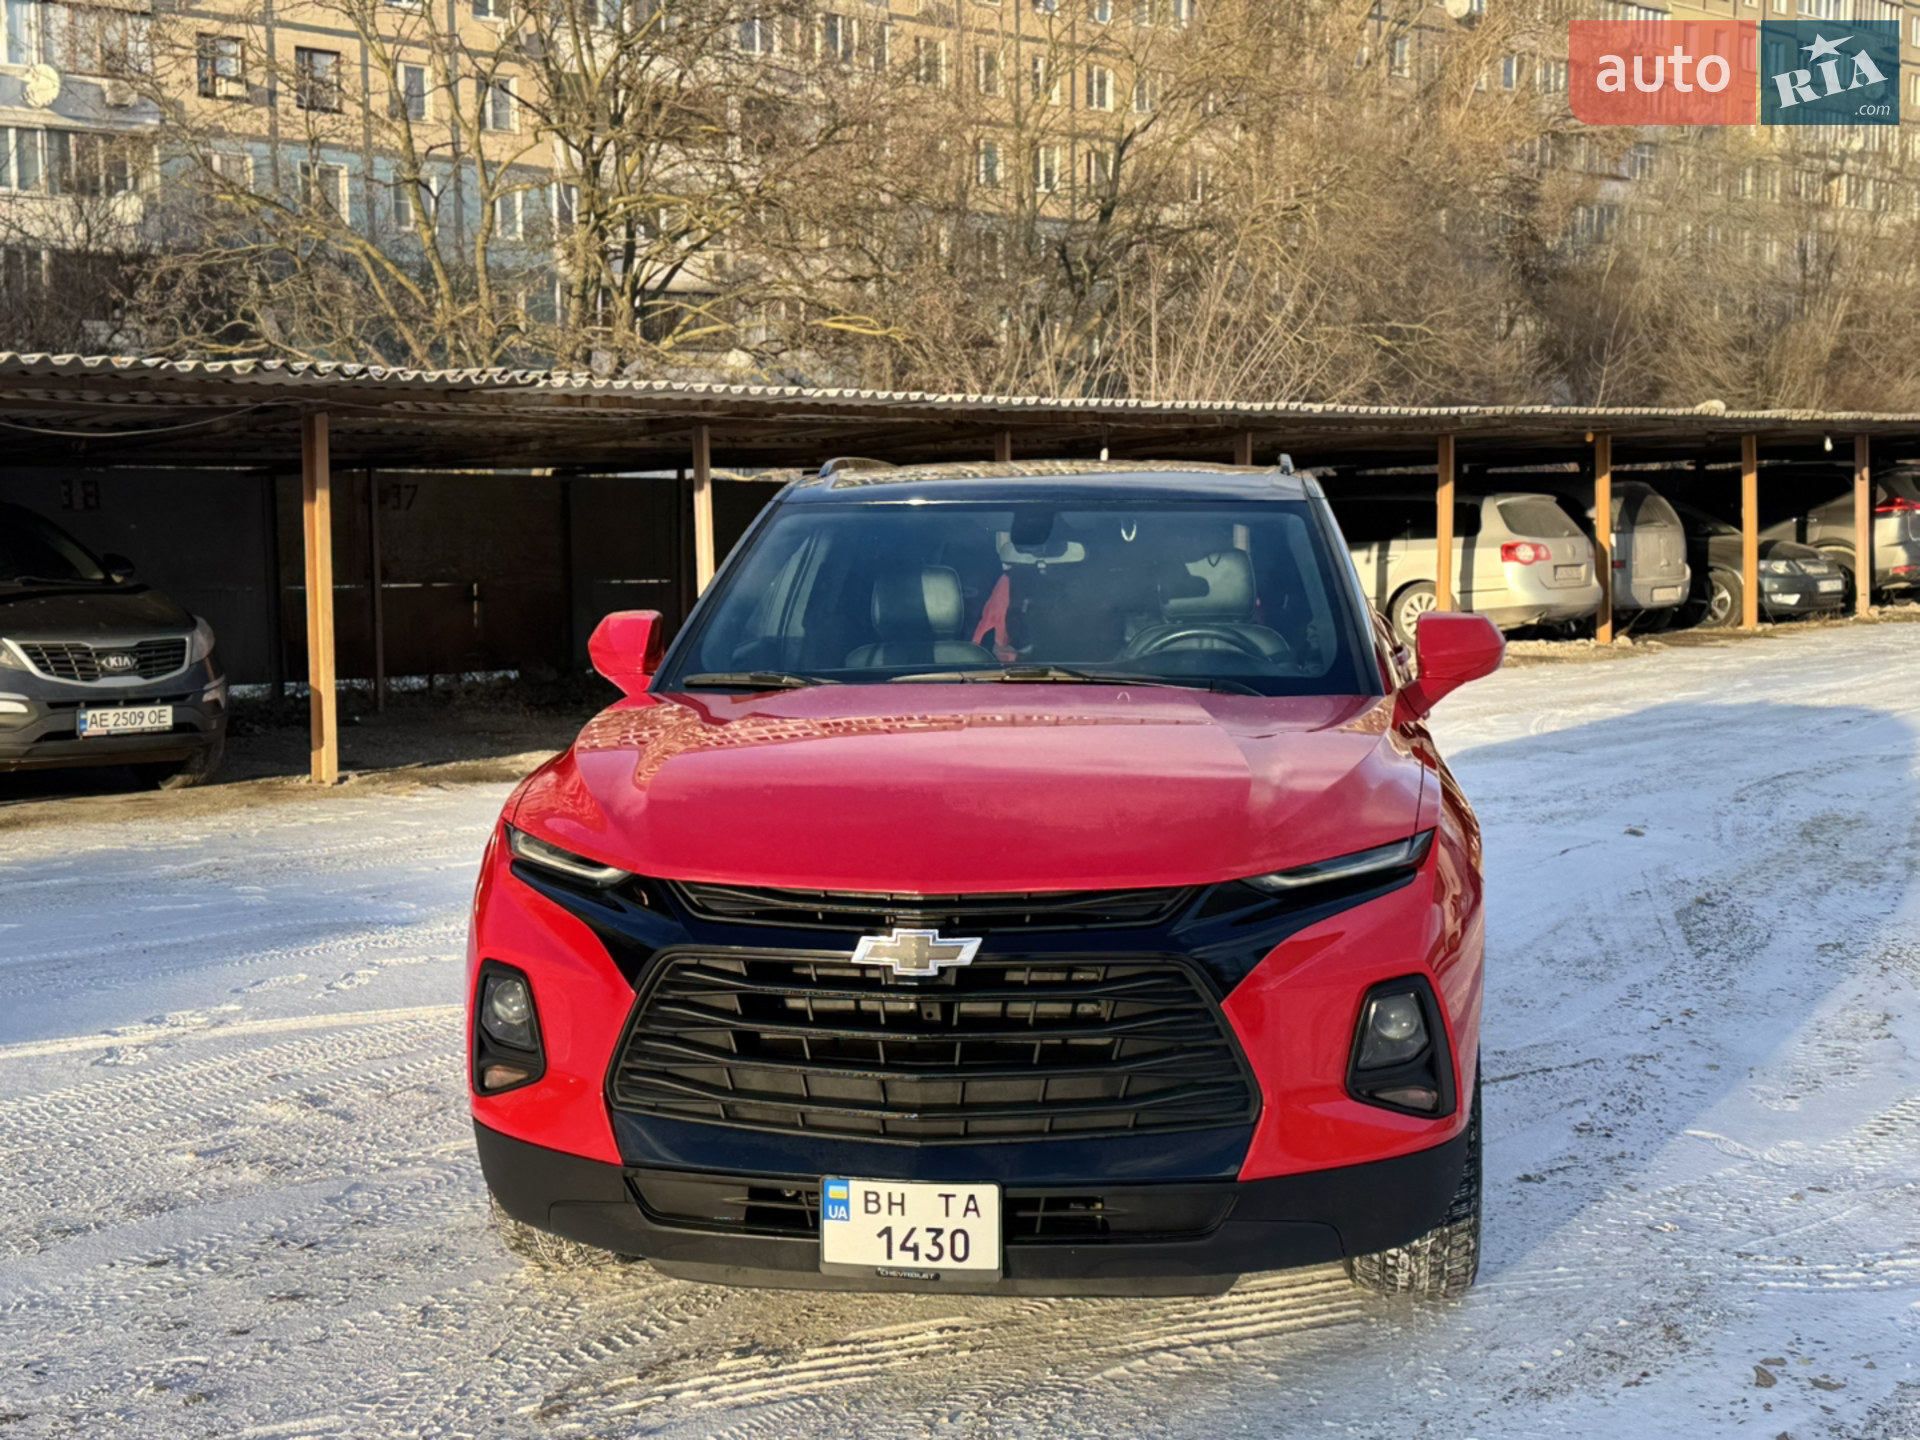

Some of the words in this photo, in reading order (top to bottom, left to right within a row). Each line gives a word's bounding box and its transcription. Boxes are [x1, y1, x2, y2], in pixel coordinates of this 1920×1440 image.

[108, 655, 131, 668] KIA
[89, 712, 109, 729] AE
[113, 710, 145, 727] 2509
[148, 708, 167, 725] OE
[828, 1205, 848, 1220] UA
[864, 1190, 905, 1217] BH
[938, 1193, 981, 1218] TA
[876, 1225, 970, 1263] 1430
